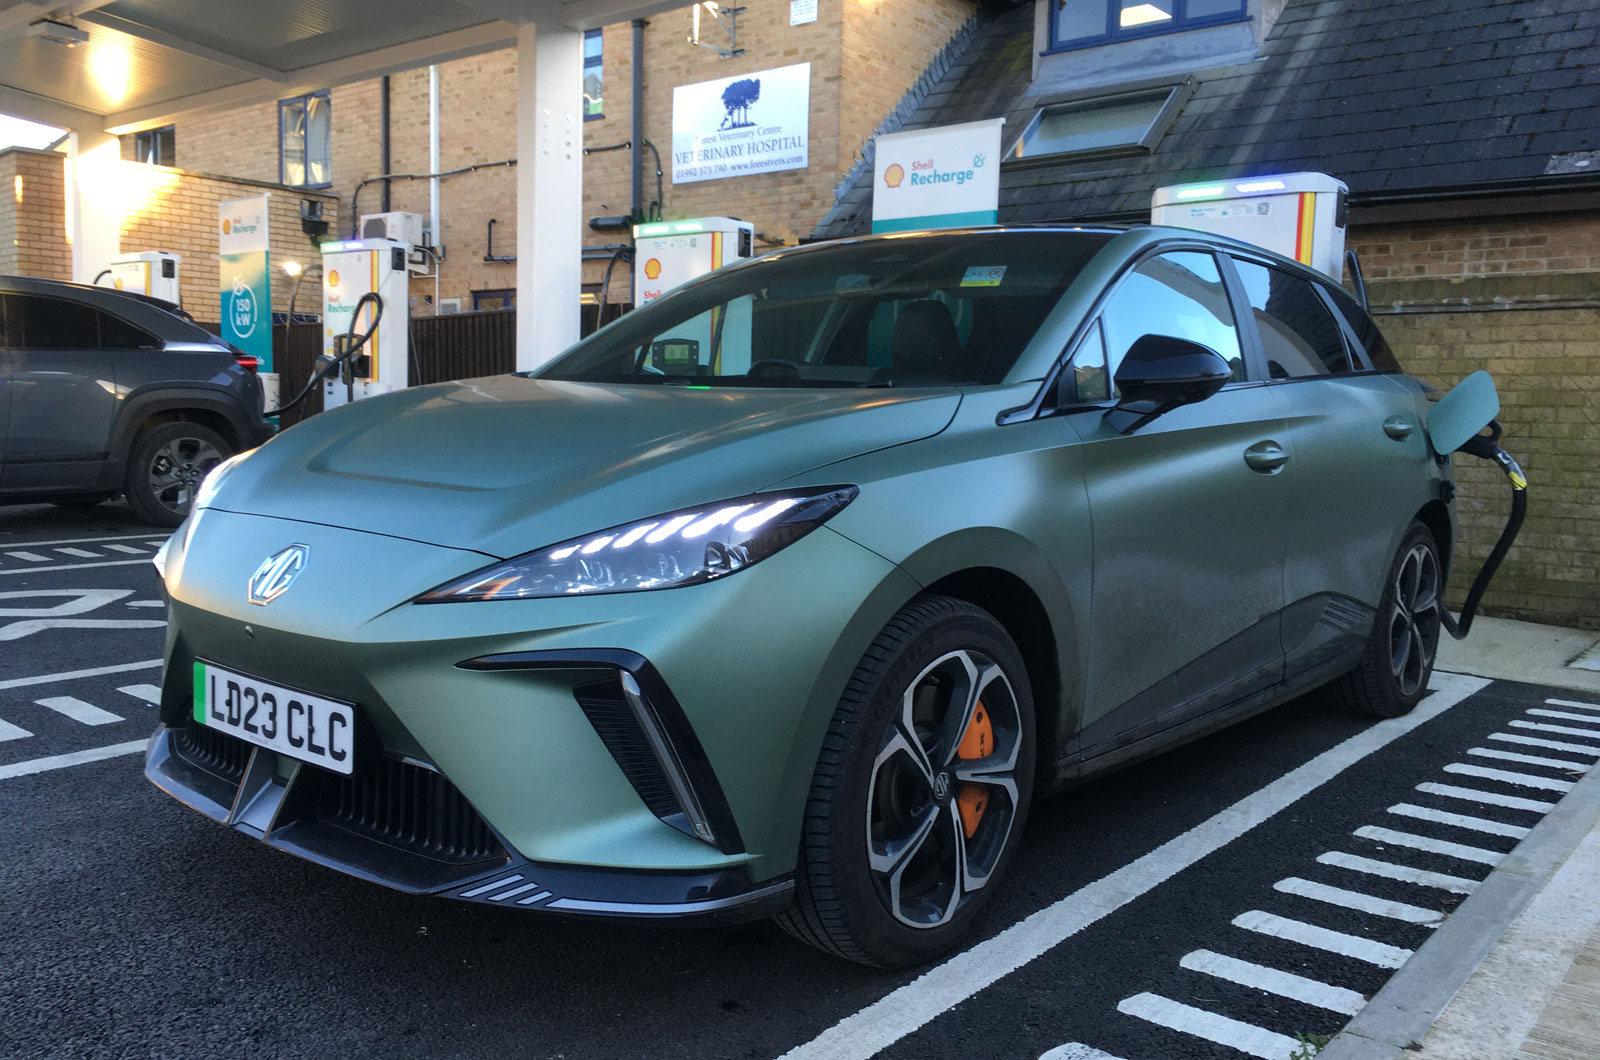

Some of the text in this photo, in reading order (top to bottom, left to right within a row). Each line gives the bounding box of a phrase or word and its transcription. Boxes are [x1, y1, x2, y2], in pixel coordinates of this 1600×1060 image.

[694, 126, 782, 145] orest Veterinary Centre
[675, 136, 805, 164] VETERINARY HOSPITAL
[731, 155, 803, 171] www.forestvets.com
[911, 159, 934, 171] Shell
[910, 169, 974, 186] Recharge
[644, 289, 661, 299] Shell
[236, 298, 250, 312] 150
[328, 302, 357, 315] Recharg
[236, 312, 251, 326] kW
[249, 547, 305, 600] MG
[211, 674, 347, 762] LD23 CLC
